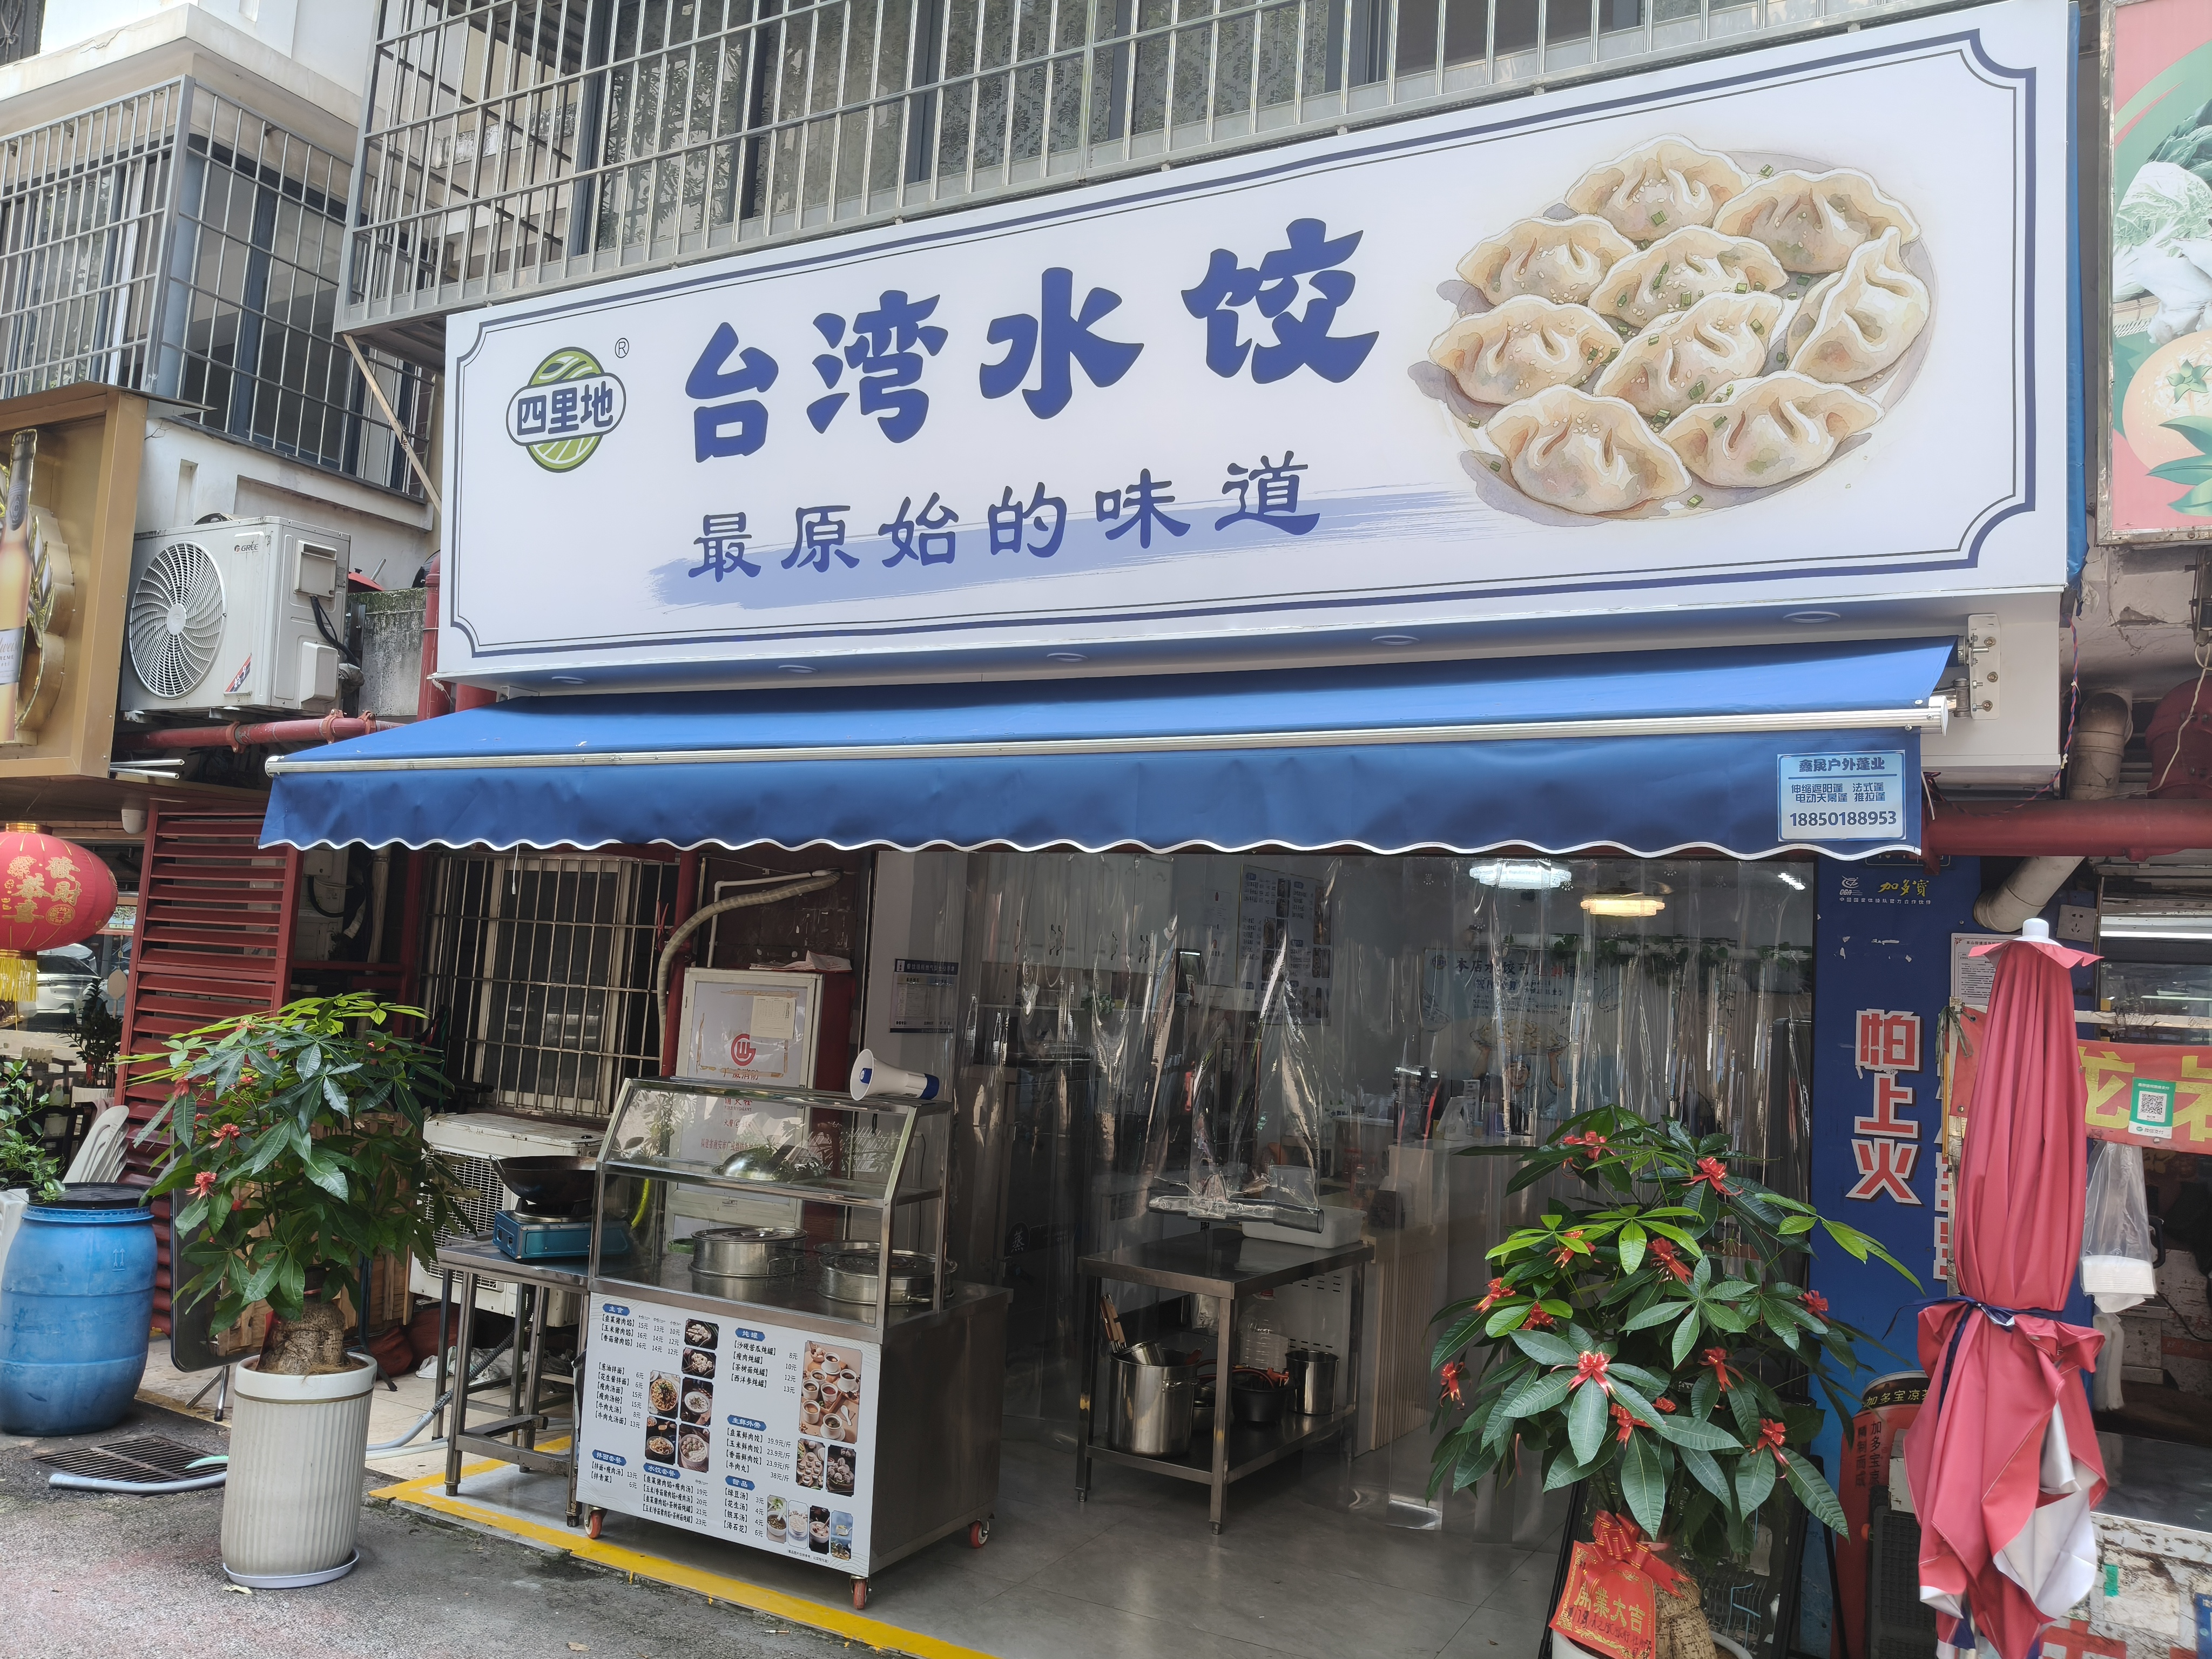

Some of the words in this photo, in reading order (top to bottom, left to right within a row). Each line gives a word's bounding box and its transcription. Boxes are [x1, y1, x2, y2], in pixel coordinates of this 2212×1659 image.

[685, 218, 1379, 463] 台湾水饺
[517, 380, 613, 436] 四里地
[689, 450, 1319, 582] 最原始的味道
[241, 543, 259, 551] GREE
[1790, 811, 1897, 826] 18850188953
[1845, 1009, 1923, 1204] 怕上火
[609, 1305, 624, 1314] 主食
[785, 1374, 796, 1382] 12元
[784, 1386, 795, 1394] 13元
[767, 1438, 791, 1448] 19.9元/斤
[767, 1449, 791, 1459] 23.9元/斤
[766, 1460, 790, 1471] 23.9元/斤
[770, 1472, 789, 1482] 38元/斤
[732, 1478, 748, 1488] 甜品
[697, 1488, 708, 1496] 19元
[696, 1508, 707, 1516] 21元
[696, 1518, 707, 1526] 23元
